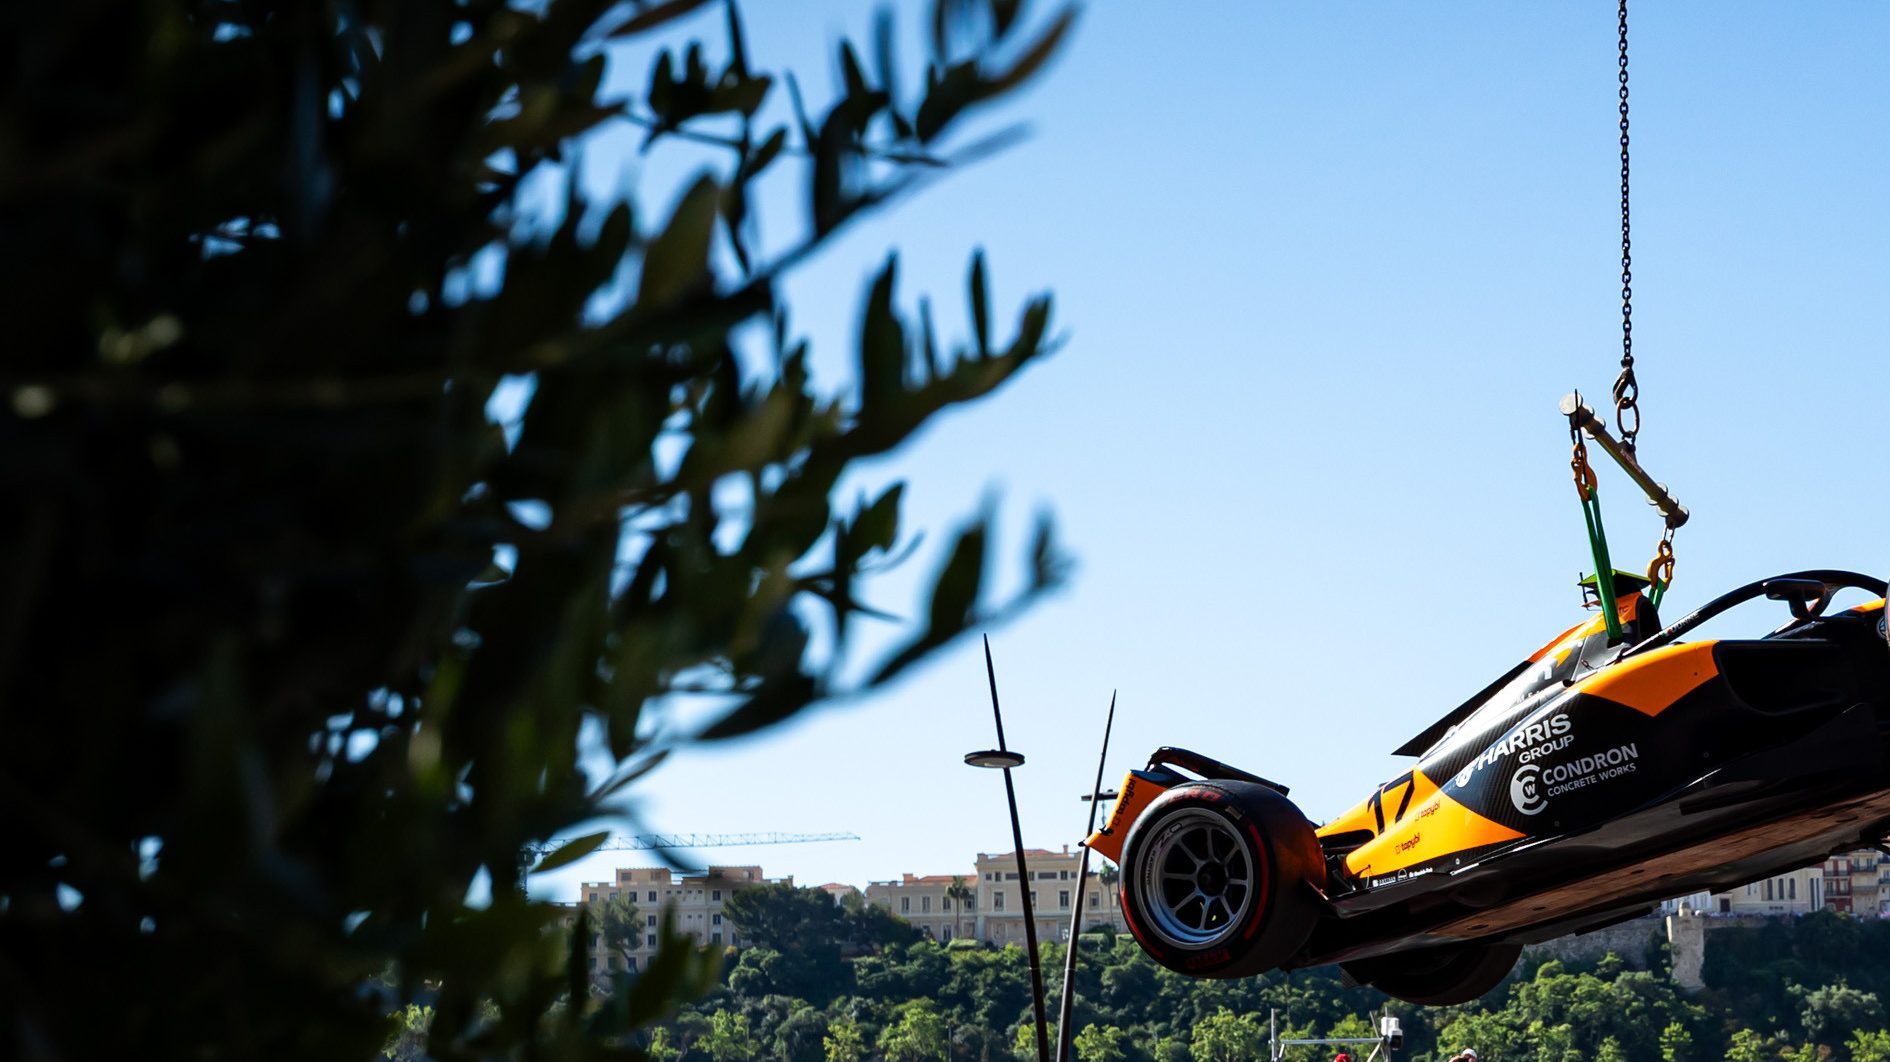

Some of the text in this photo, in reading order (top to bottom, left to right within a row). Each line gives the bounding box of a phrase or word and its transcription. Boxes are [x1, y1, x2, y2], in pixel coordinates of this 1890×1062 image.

[1477, 713, 1572, 771] HARRIS
[1518, 734, 1575, 764] GROUP
[1542, 742, 1639, 785] CONDRON
[1547, 762, 1637, 798] CONCRETE WORKS
[1367, 770, 1415, 836] 17
